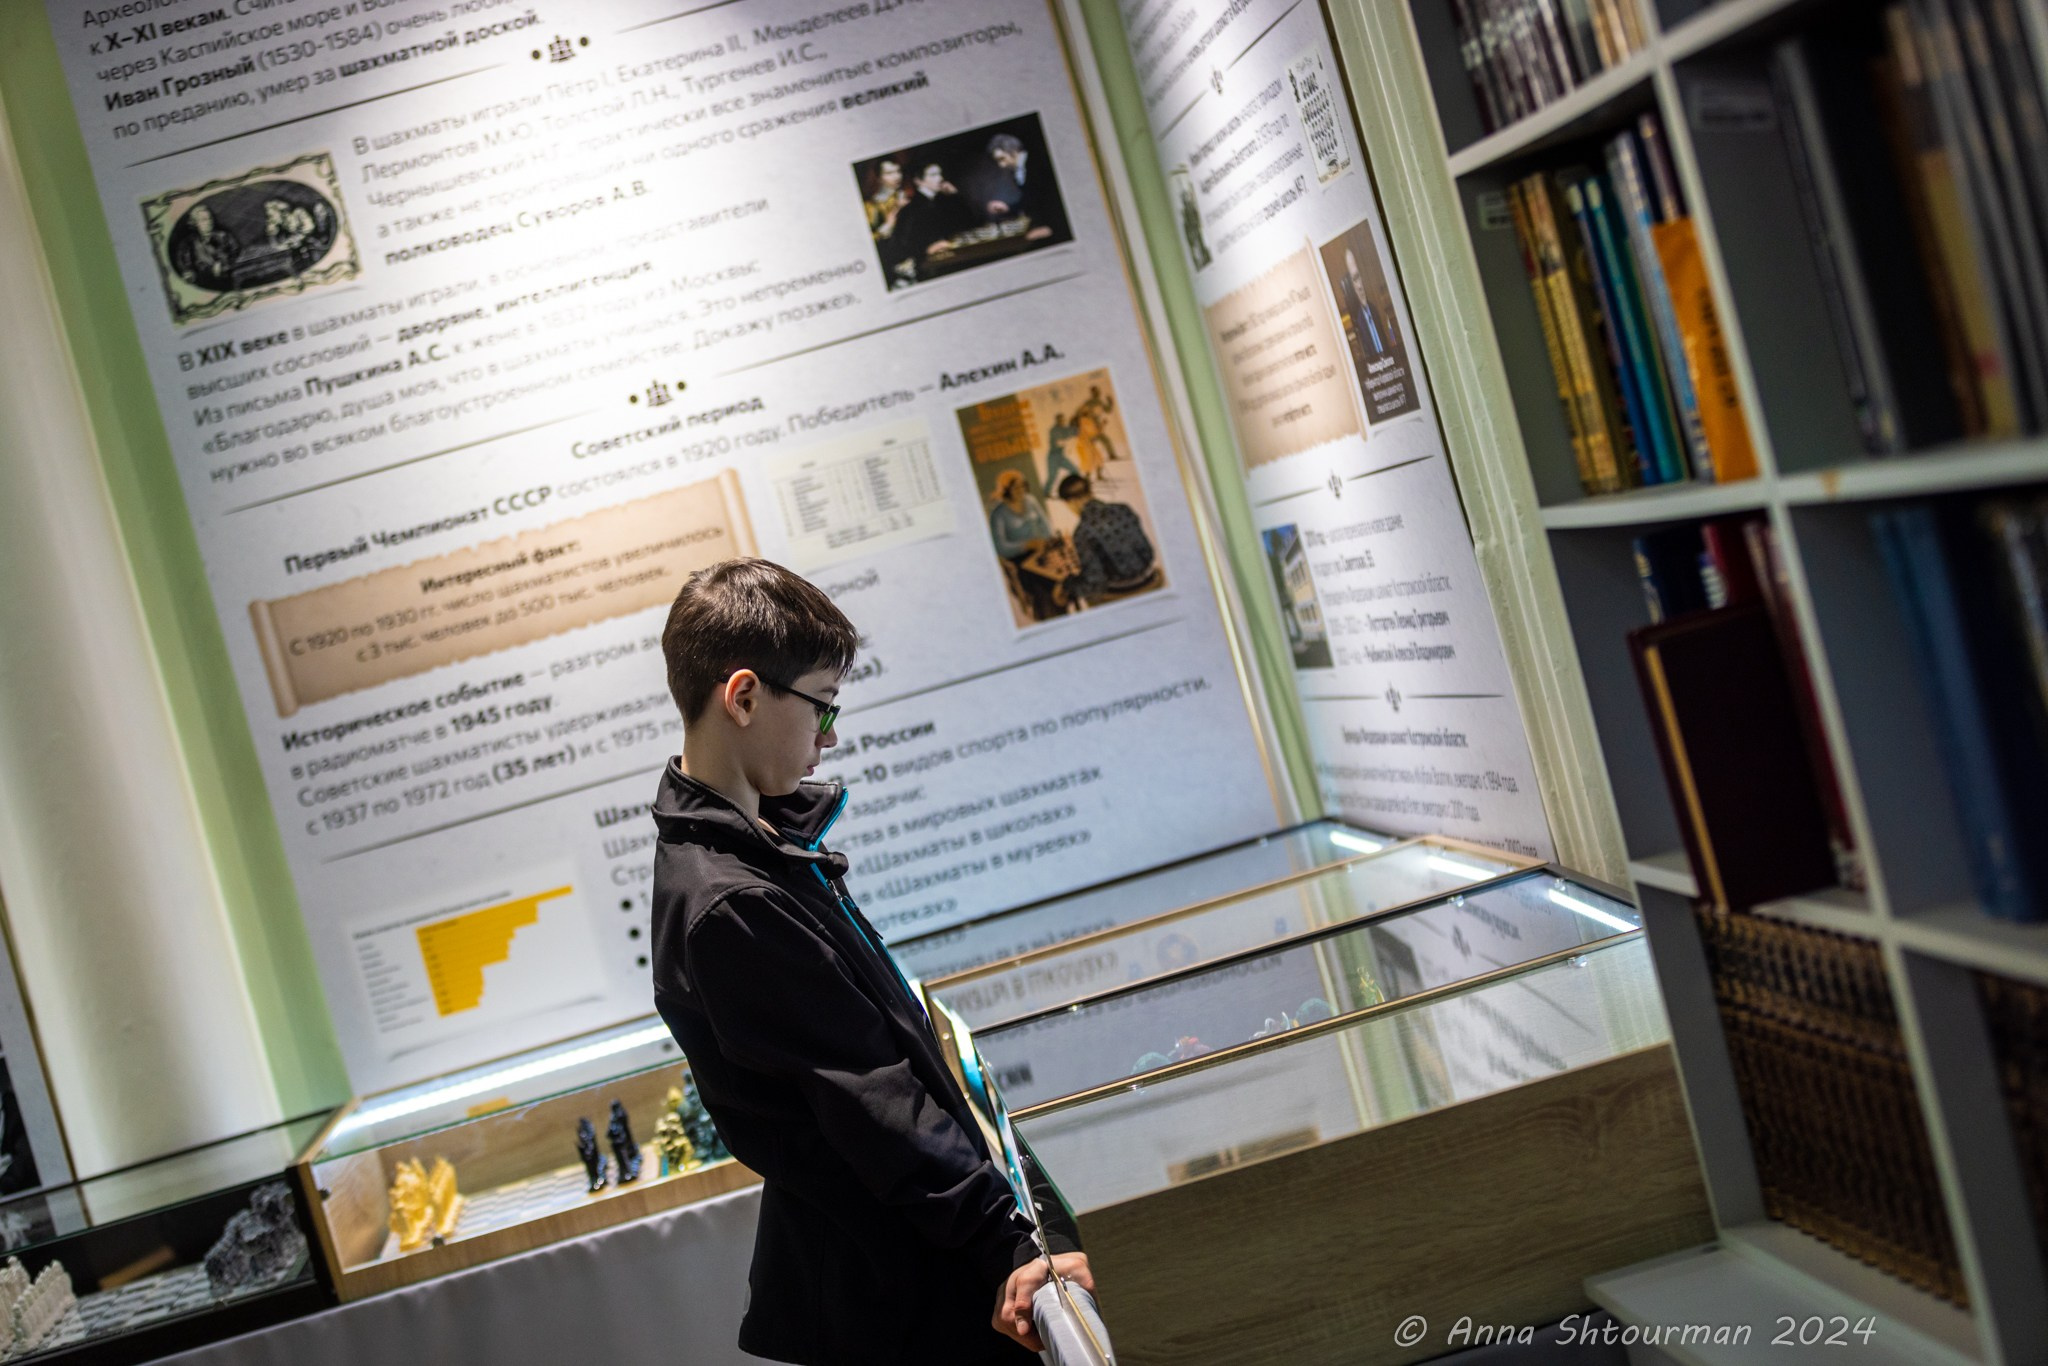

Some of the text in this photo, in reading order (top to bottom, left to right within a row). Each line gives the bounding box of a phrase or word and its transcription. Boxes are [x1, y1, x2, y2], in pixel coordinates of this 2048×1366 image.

[94, 1, 359, 82] через Каспийское море и
[101, 6, 232, 52] X–XI векам.
[102, 9, 448, 113] Иван Грозный (1530-1584) очень
[111, 120, 141, 140] по
[141, 90, 256, 133] преданию,
[254, 73, 311, 105] умер
[311, 66, 337, 86] за
[336, 29, 460, 78] шахматной
[350, 134, 371, 157] В
[369, 112, 469, 151] шахматы
[468, 92, 544, 123] играли
[614, 41, 726, 84] Екатерина
[724, 32, 748, 53] II,
[750, 1, 872, 46] Менделеев
[359, 139, 481, 185] Лермонтов
[538, 94, 627, 132] Толстой
[678, 57, 777, 95] Тургенев
[776, 40, 829, 68] И.С.,
[364, 151, 527, 208] Чернышевский
[708, 95, 746, 118] все
[746, 59, 873, 108] знаменитые
[873, 19, 1024, 71] композиторы,
[375, 222, 391, 239] а
[391, 205, 455, 233] также
[457, 197, 483, 213] не
[659, 127, 736, 161] одного
[735, 98, 839, 140] сражения
[838, 68, 931, 111] великий
[382, 220, 515, 267] полководец
[514, 194, 607, 229] Суворов
[174, 350, 196, 373] В
[194, 338, 238, 368] XIX
[238, 328, 291, 356] веке
[305, 298, 405, 338] шахматы
[404, 277, 485, 309] играли,
[184, 306, 492, 401] высших сословий дворяне,
[200, 406, 340, 455] «Благодарю,
[339, 389, 396, 420] душа
[396, 376, 447, 401] моя,
[445, 365, 485, 386] что
[501, 334, 599, 373] шахматы
[695, 294, 737, 318] Это
[738, 258, 867, 305] непременно
[191, 404, 225, 428] Из
[224, 385, 304, 419] письма
[302, 357, 405, 398] Пушкина
[406, 341, 451, 369] А.С.
[469, 326, 521, 351] жене
[207, 450, 281, 484] нужно
[279, 443, 309, 464] во
[309, 421, 388, 456] всяком
[386, 370, 575, 434] благоустроенном
[691, 313, 775, 352] Докажу
[282, 534, 370, 576] Первый
[369, 505, 489, 548] Чемпионат
[491, 483, 553, 516] СССР
[555, 458, 663, 499] состоялся
[680, 435, 732, 463] 1920
[785, 388, 916, 434] Победитель
[937, 357, 1019, 392] Алехин
[1020, 342, 1066, 369] А.А.
[569, 395, 766, 460] Советский период
[285, 635, 307, 661] С
[304, 624, 350, 652] 1920
[347, 620, 375, 640] по
[374, 605, 420, 631] 1930
[494, 555, 612, 599] шахматистов
[611, 524, 726, 568] увеличилось
[354, 647, 369, 663] с
[366, 640, 383, 660] 3
[419, 613, 492, 643] человек
[493, 606, 519, 626] до
[517, 592, 556, 617] 500
[593, 565, 668, 593] человек.
[418, 538, 582, 595] Интересный факт:
[279, 640, 637, 753] Историческое событие разгром
[304, 728, 431, 780] радиоматче
[448, 704, 502, 734] 1945
[858, 719, 937, 753] России
[890, 675, 1212, 778] видов спорта по популярности.
[295, 764, 409, 808] Советские
[409, 728, 542, 777] шахматисты
[303, 719, 660, 837] с 1937 по 1972 год (35 лет) и с 1975
[851, 784, 927, 819] задачи:
[900, 795, 997, 834] мировых
[997, 764, 1104, 808] шахматах
[855, 834, 967, 876] «Шахматы
[982, 802, 1078, 841] школах»
[874, 858, 989, 901] «Шахматы
[1004, 827, 1093, 865] музеях»
